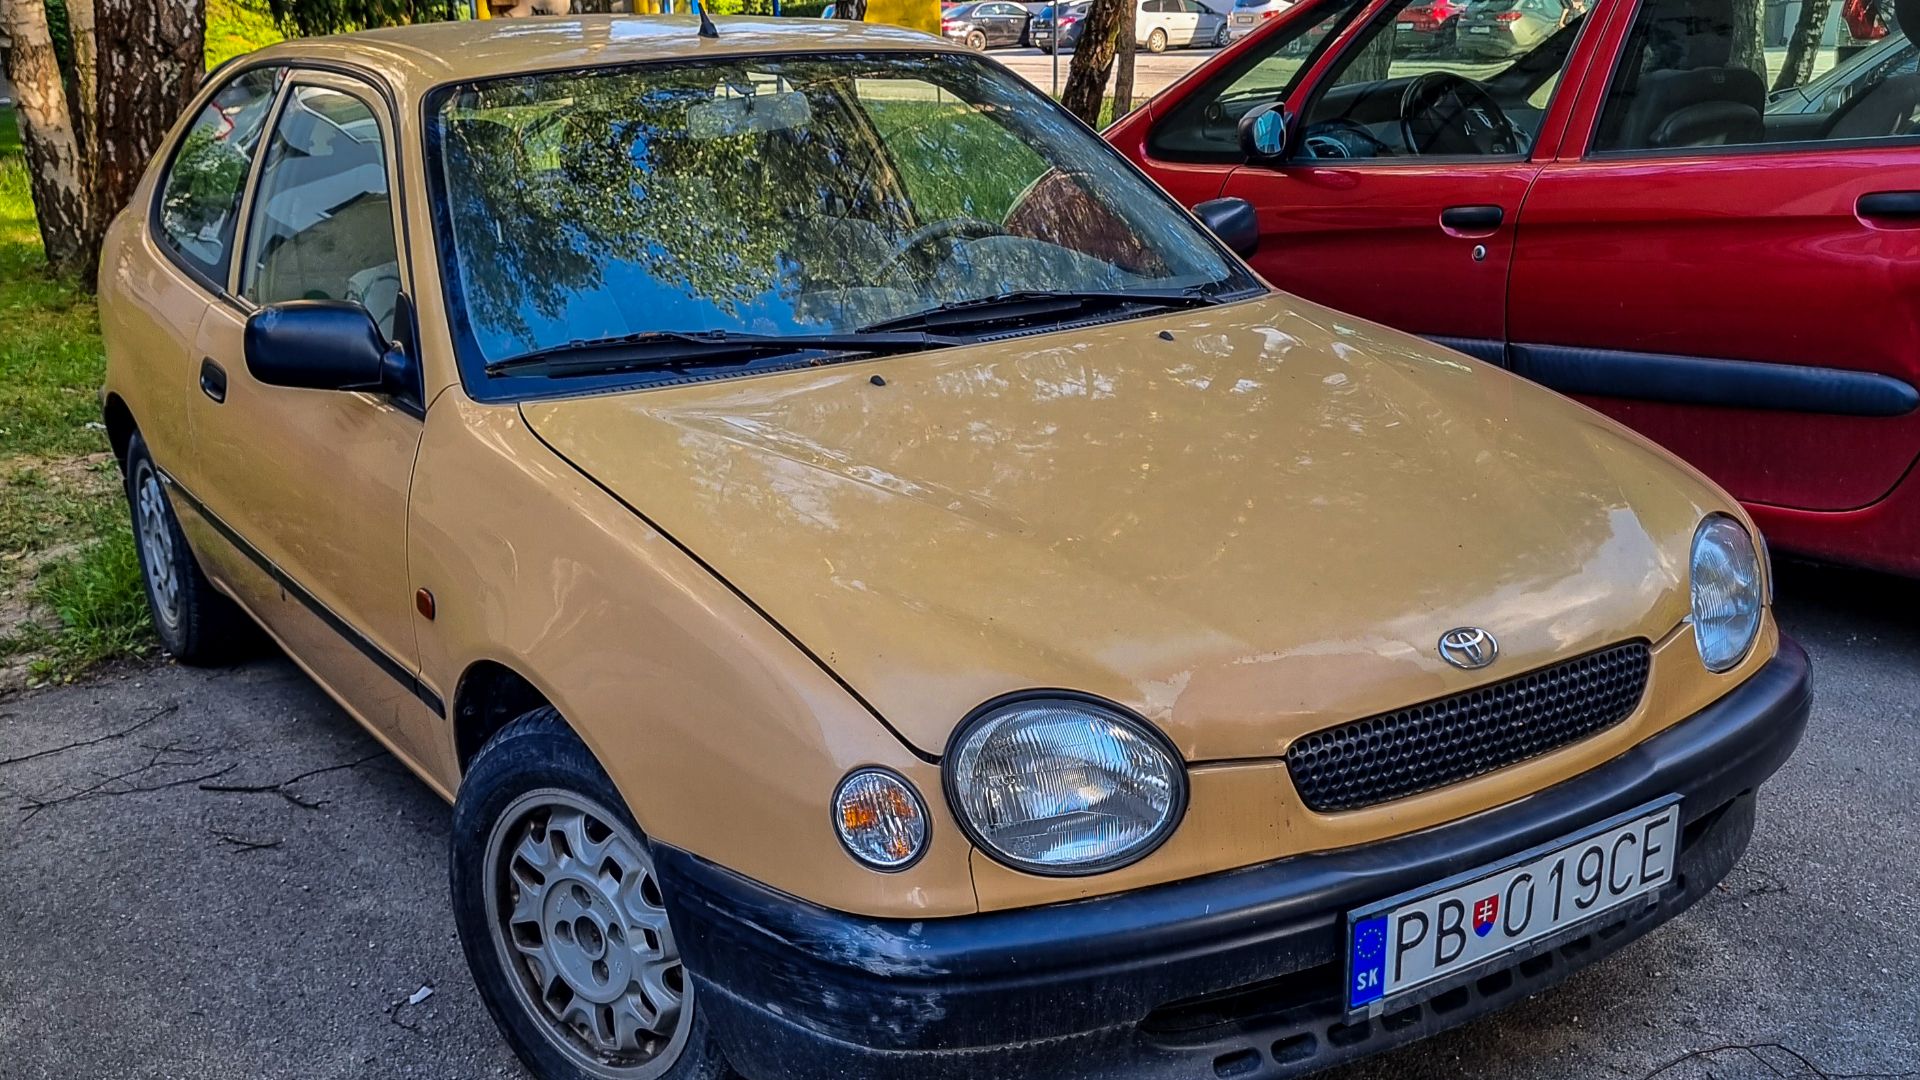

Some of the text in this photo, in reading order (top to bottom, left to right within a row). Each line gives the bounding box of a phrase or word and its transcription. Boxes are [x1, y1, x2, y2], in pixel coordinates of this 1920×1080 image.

[1393, 815, 1670, 983] PB 019CE
[1357, 967, 1379, 991] SK
